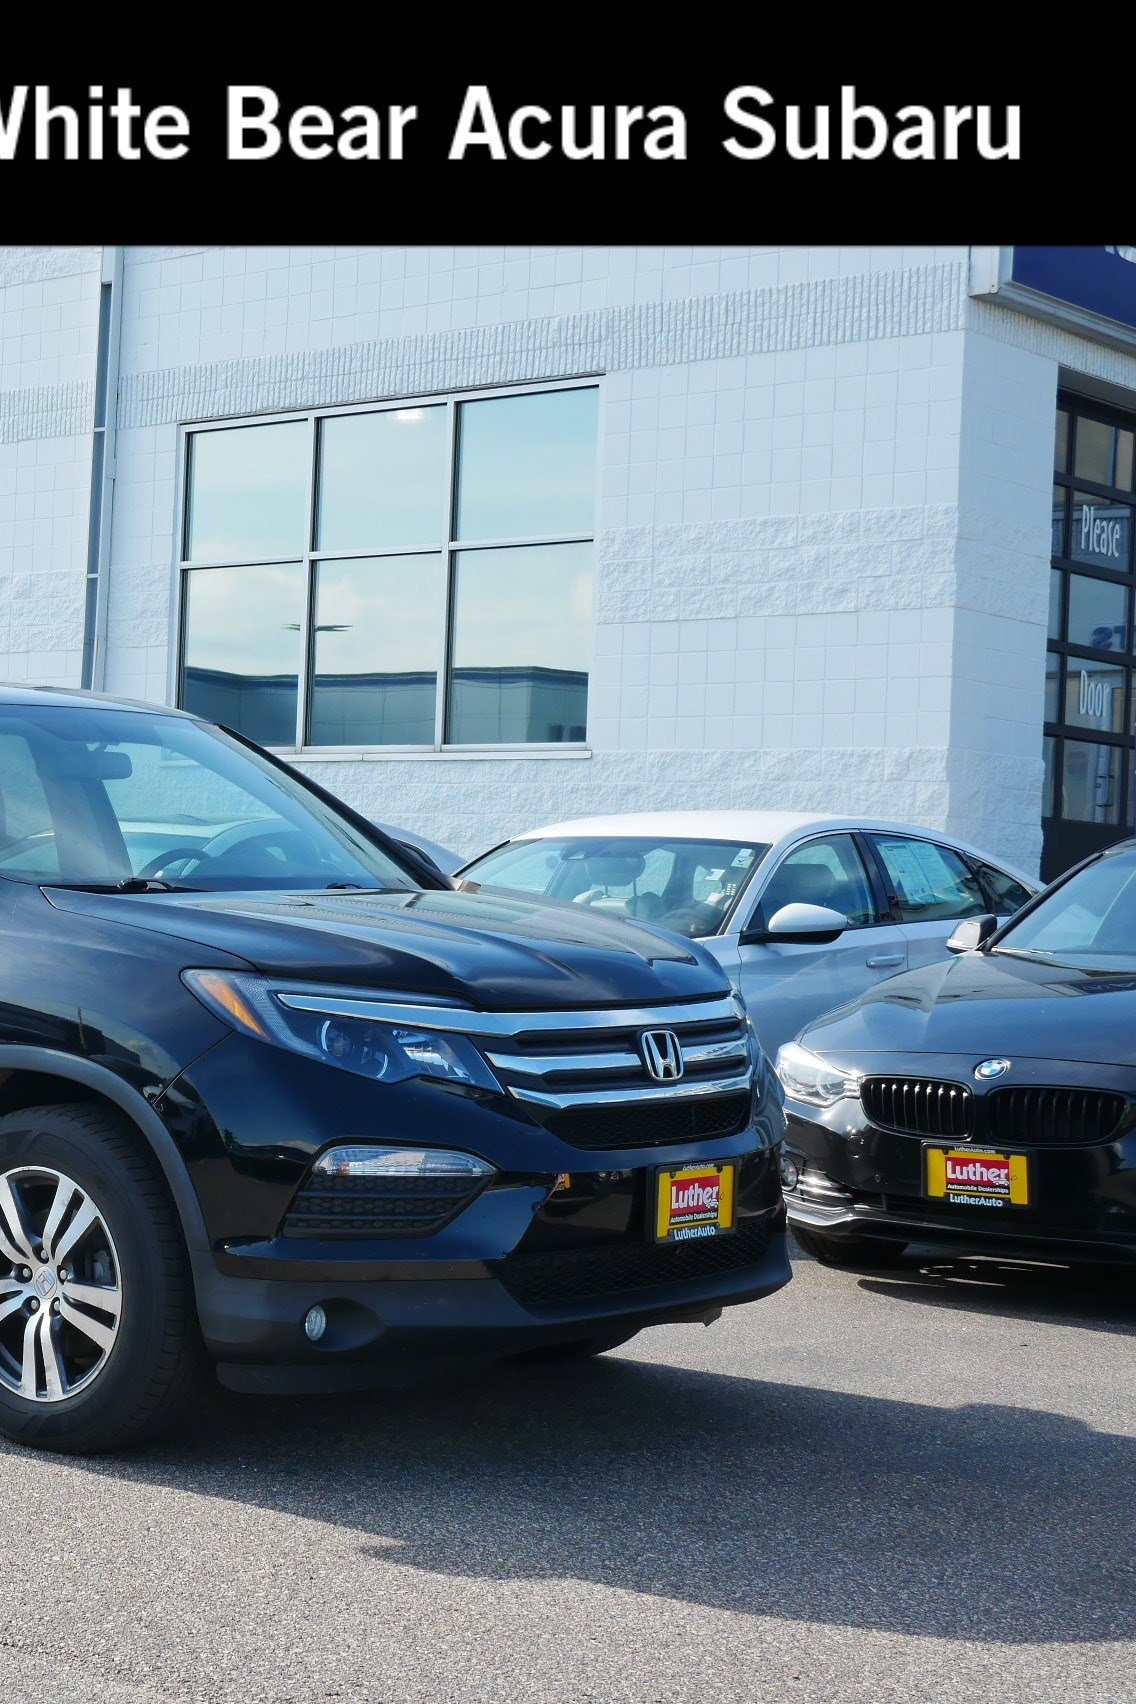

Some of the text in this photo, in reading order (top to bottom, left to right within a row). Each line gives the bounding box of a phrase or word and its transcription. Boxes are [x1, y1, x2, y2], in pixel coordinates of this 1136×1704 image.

[1081, 504, 1120, 557] Please
[1079, 669, 1111, 717] Door
[946, 1160, 1009, 1182] Luther
[671, 1182, 719, 1209] Luther
[947, 1183, 1009, 1194] Automobile Dealerships
[949, 1193, 1003, 1207] LutherAuto
[669, 1210, 718, 1224] Automobile Dealerships
[673, 1225, 716, 1240] LutherAuto
